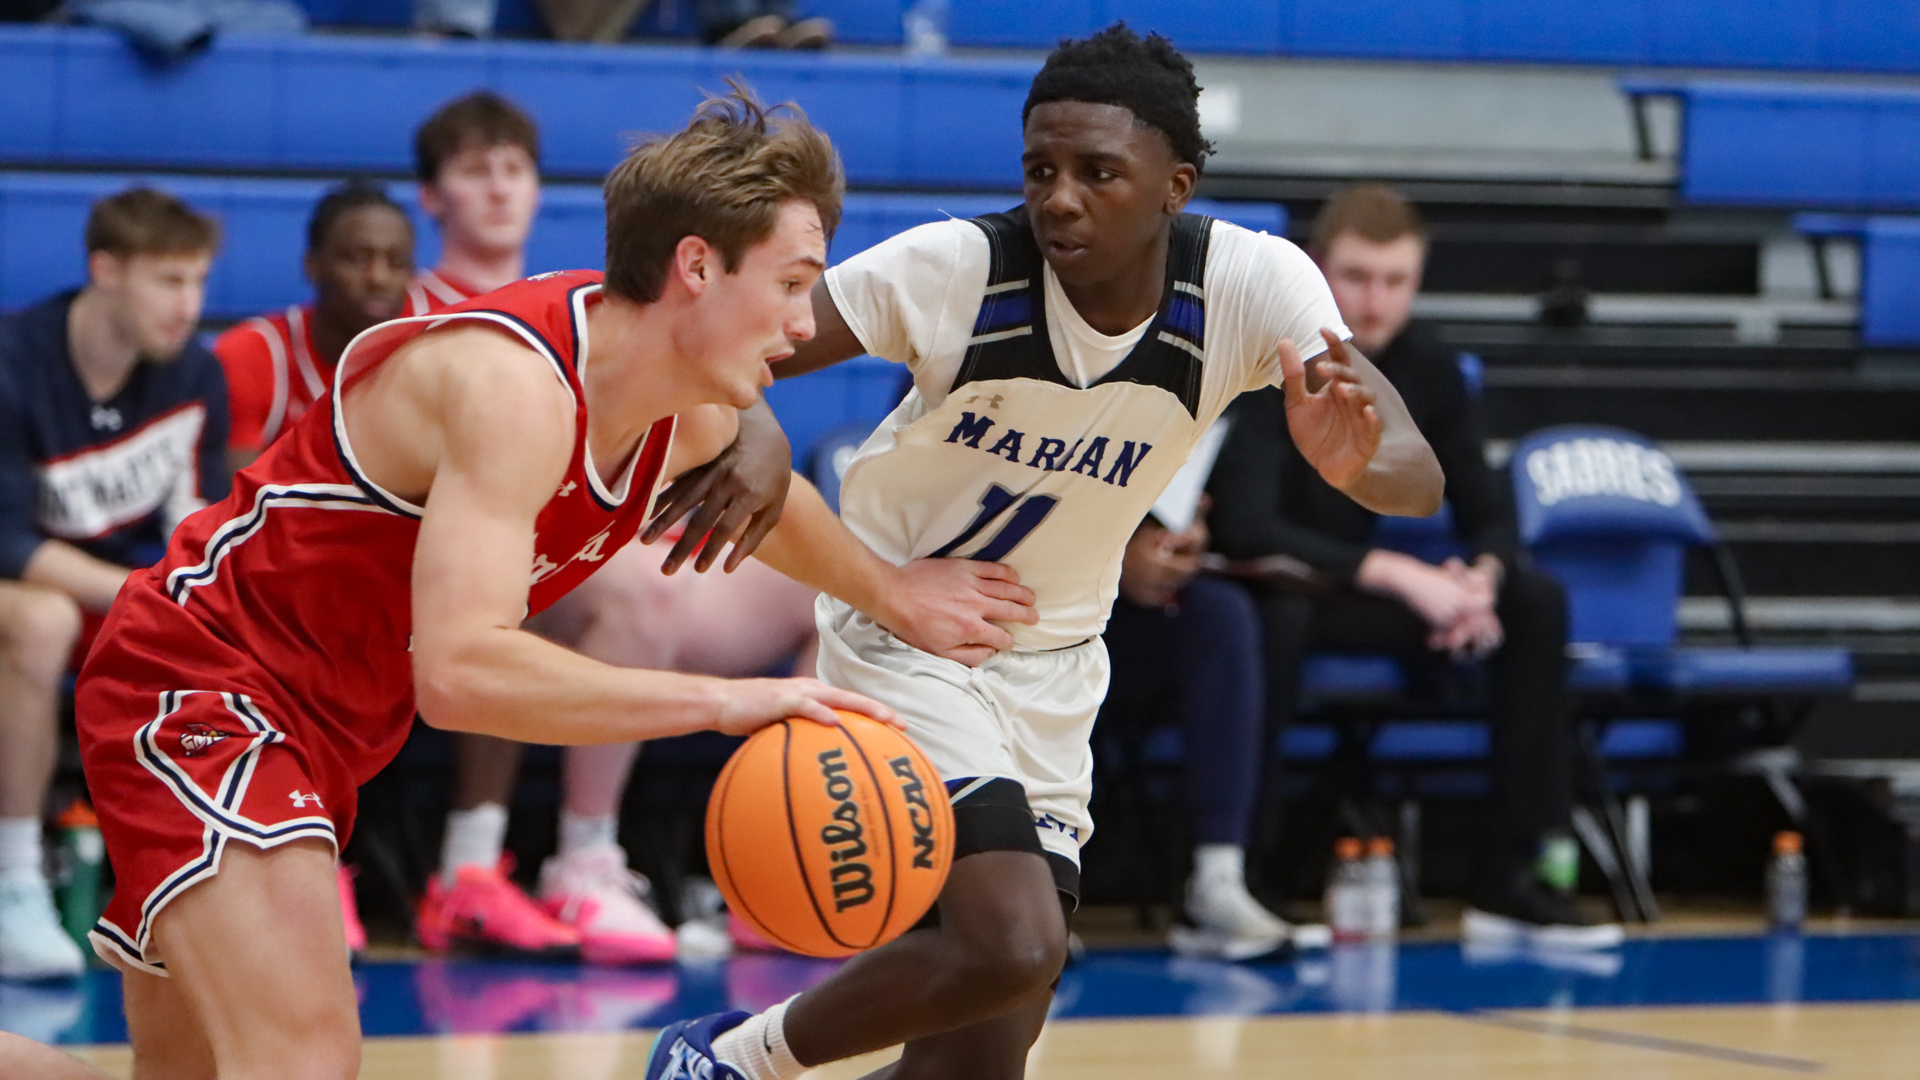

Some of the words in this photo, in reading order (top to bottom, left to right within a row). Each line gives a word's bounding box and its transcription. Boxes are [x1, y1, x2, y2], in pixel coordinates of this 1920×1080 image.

[943, 411, 1153, 487] MARIAN
[817, 746, 876, 914] Wilson
[887, 755, 935, 870] NCAA
